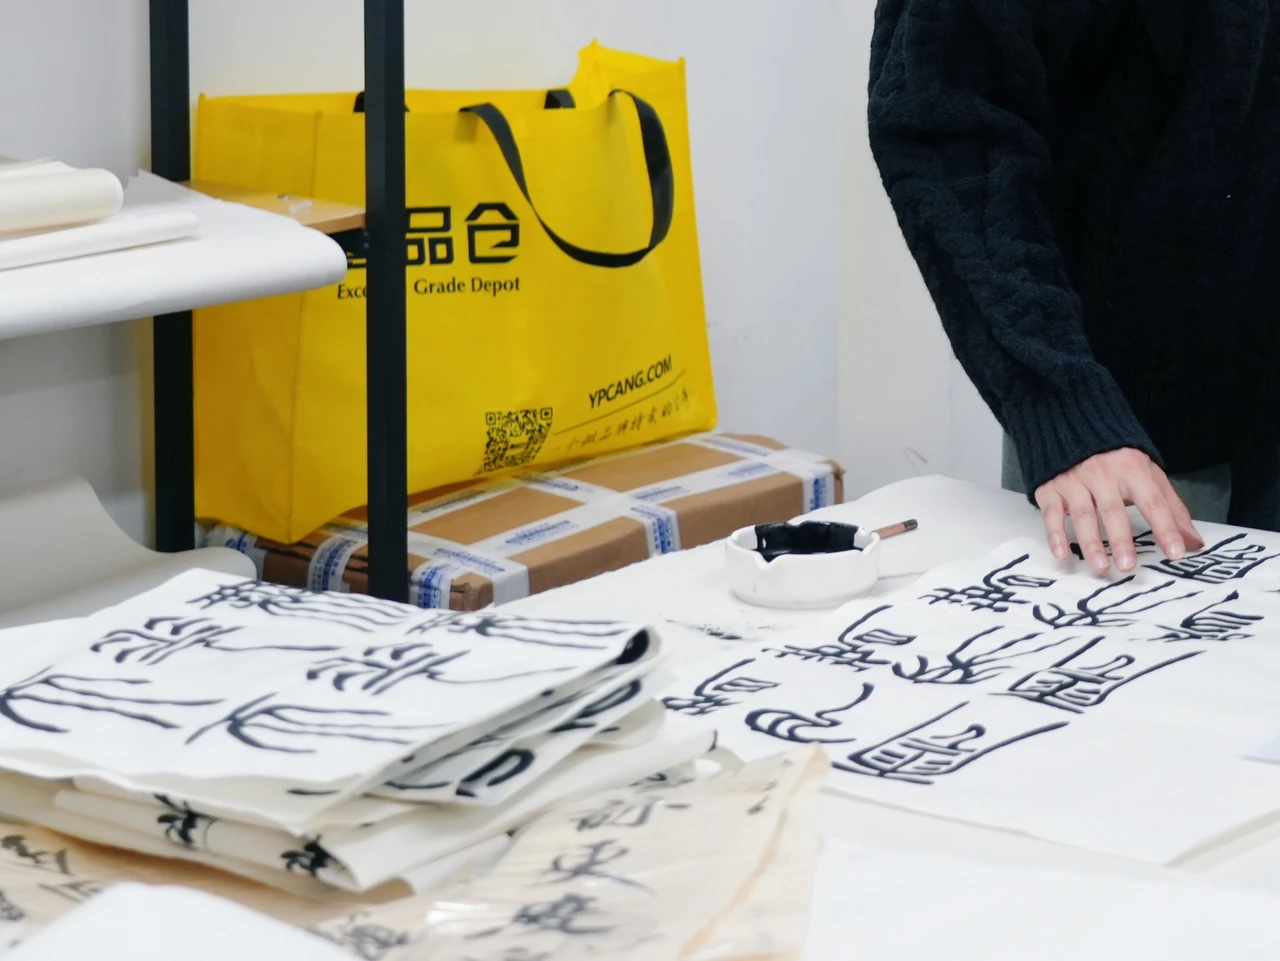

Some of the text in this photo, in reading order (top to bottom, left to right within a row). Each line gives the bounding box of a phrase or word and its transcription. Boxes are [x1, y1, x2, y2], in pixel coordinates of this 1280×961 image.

[414, 277, 466, 295] Grade
[471, 276, 521, 297] Depot
[588, 353, 673, 409] YPCANG.COM
